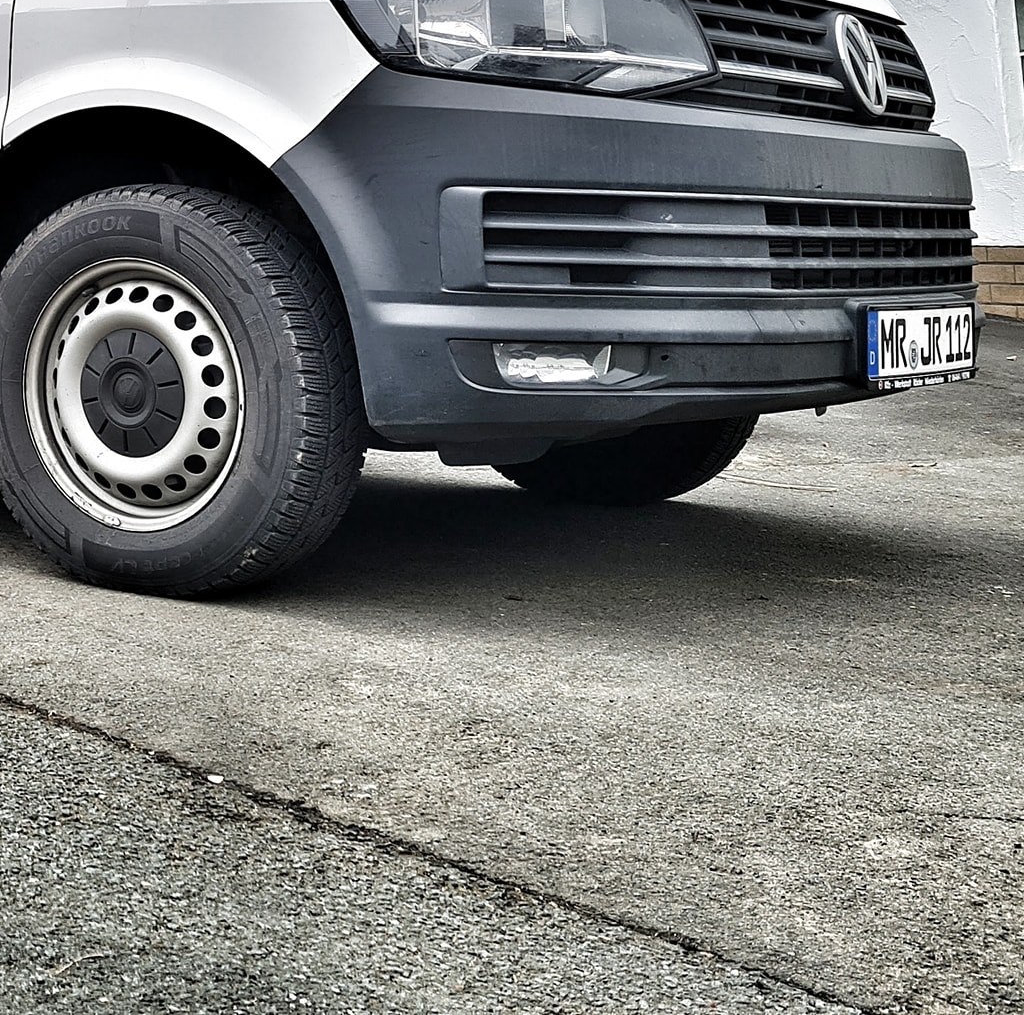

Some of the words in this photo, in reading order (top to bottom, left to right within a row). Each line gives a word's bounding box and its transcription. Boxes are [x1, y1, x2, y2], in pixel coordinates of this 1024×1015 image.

[869, 351, 876, 365] D
[881, 318, 907, 370] MR
[920, 316, 942, 366] JR
[946, 314, 970, 363] 112
